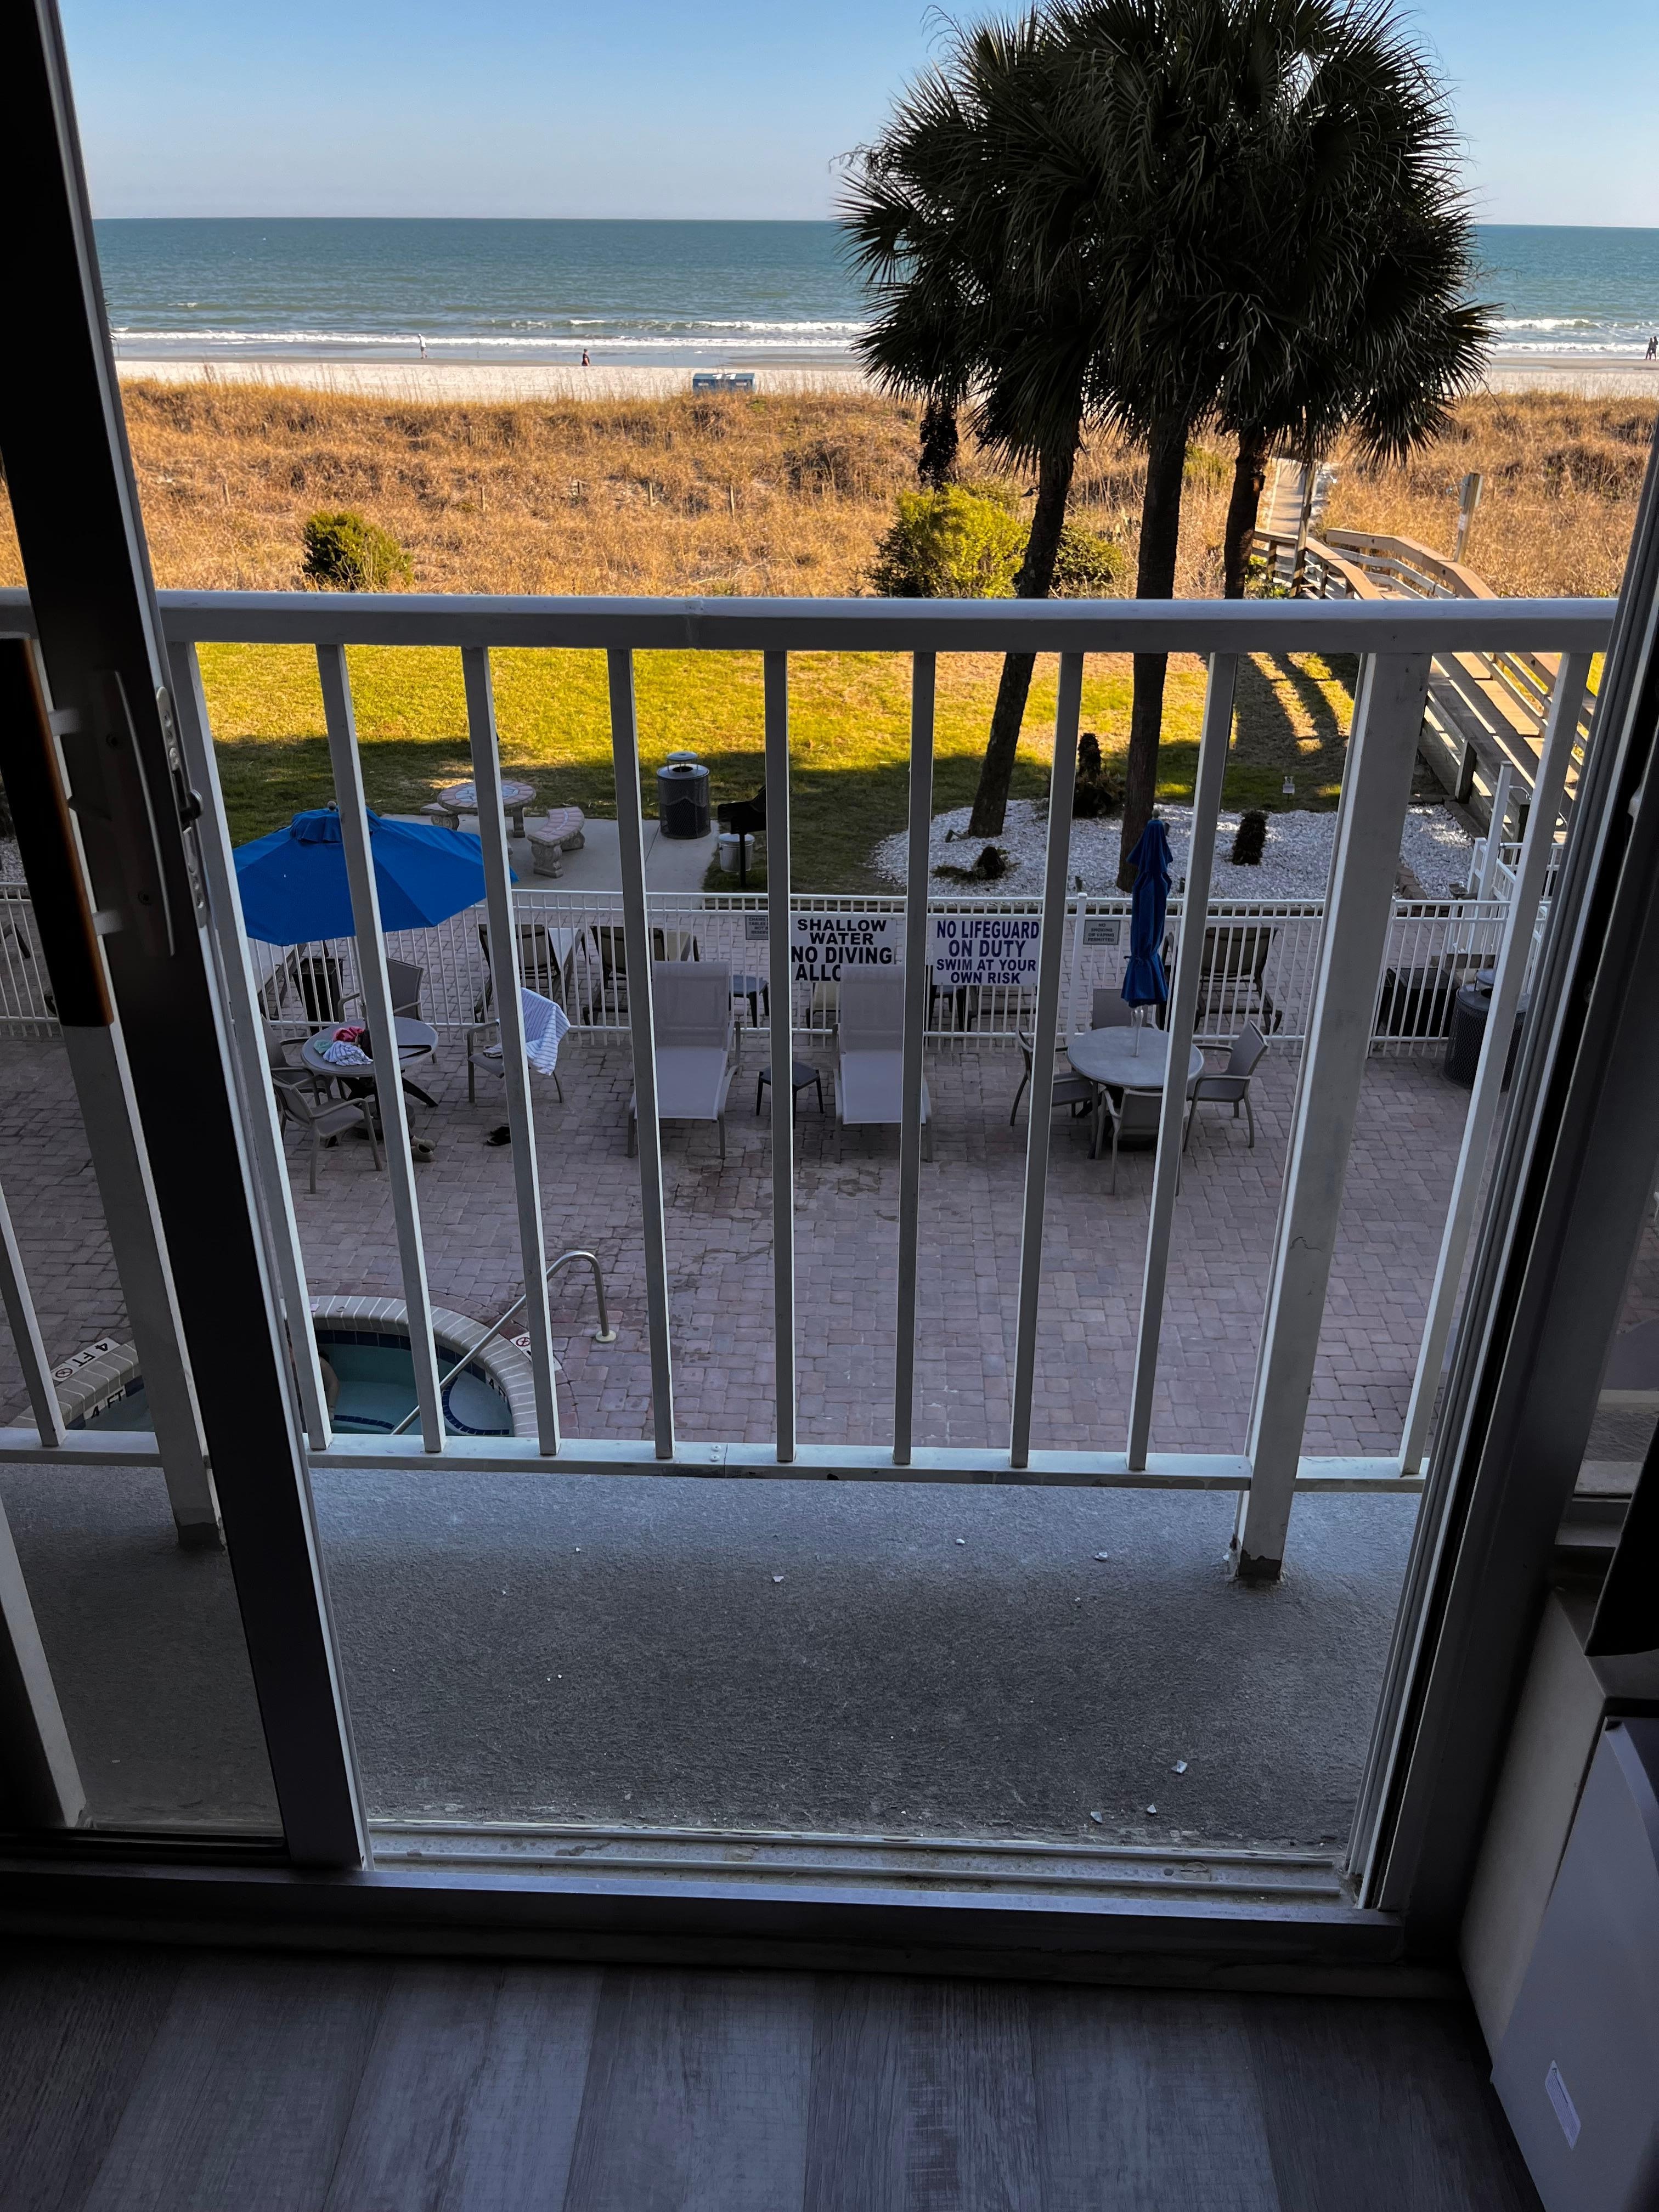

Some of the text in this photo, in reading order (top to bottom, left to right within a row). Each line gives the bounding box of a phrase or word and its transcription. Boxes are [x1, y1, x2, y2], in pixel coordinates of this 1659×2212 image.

[797, 919, 887, 932] SHALLOW
[937, 921, 1039, 939] NO LIFEGUARD
[810, 933, 874, 945] WATER
[792, 946, 892, 964] NO DIVING
[949, 940, 1026, 957] ON DUTY
[795, 964, 841, 981] ALLO
[936, 959, 1036, 971] SWIM AT YOUR
[951, 972, 1020, 984] OWN RISK
[72, 1342, 108, 1367] 4 FT
[91, 1389, 123, 1418] 4 FT
